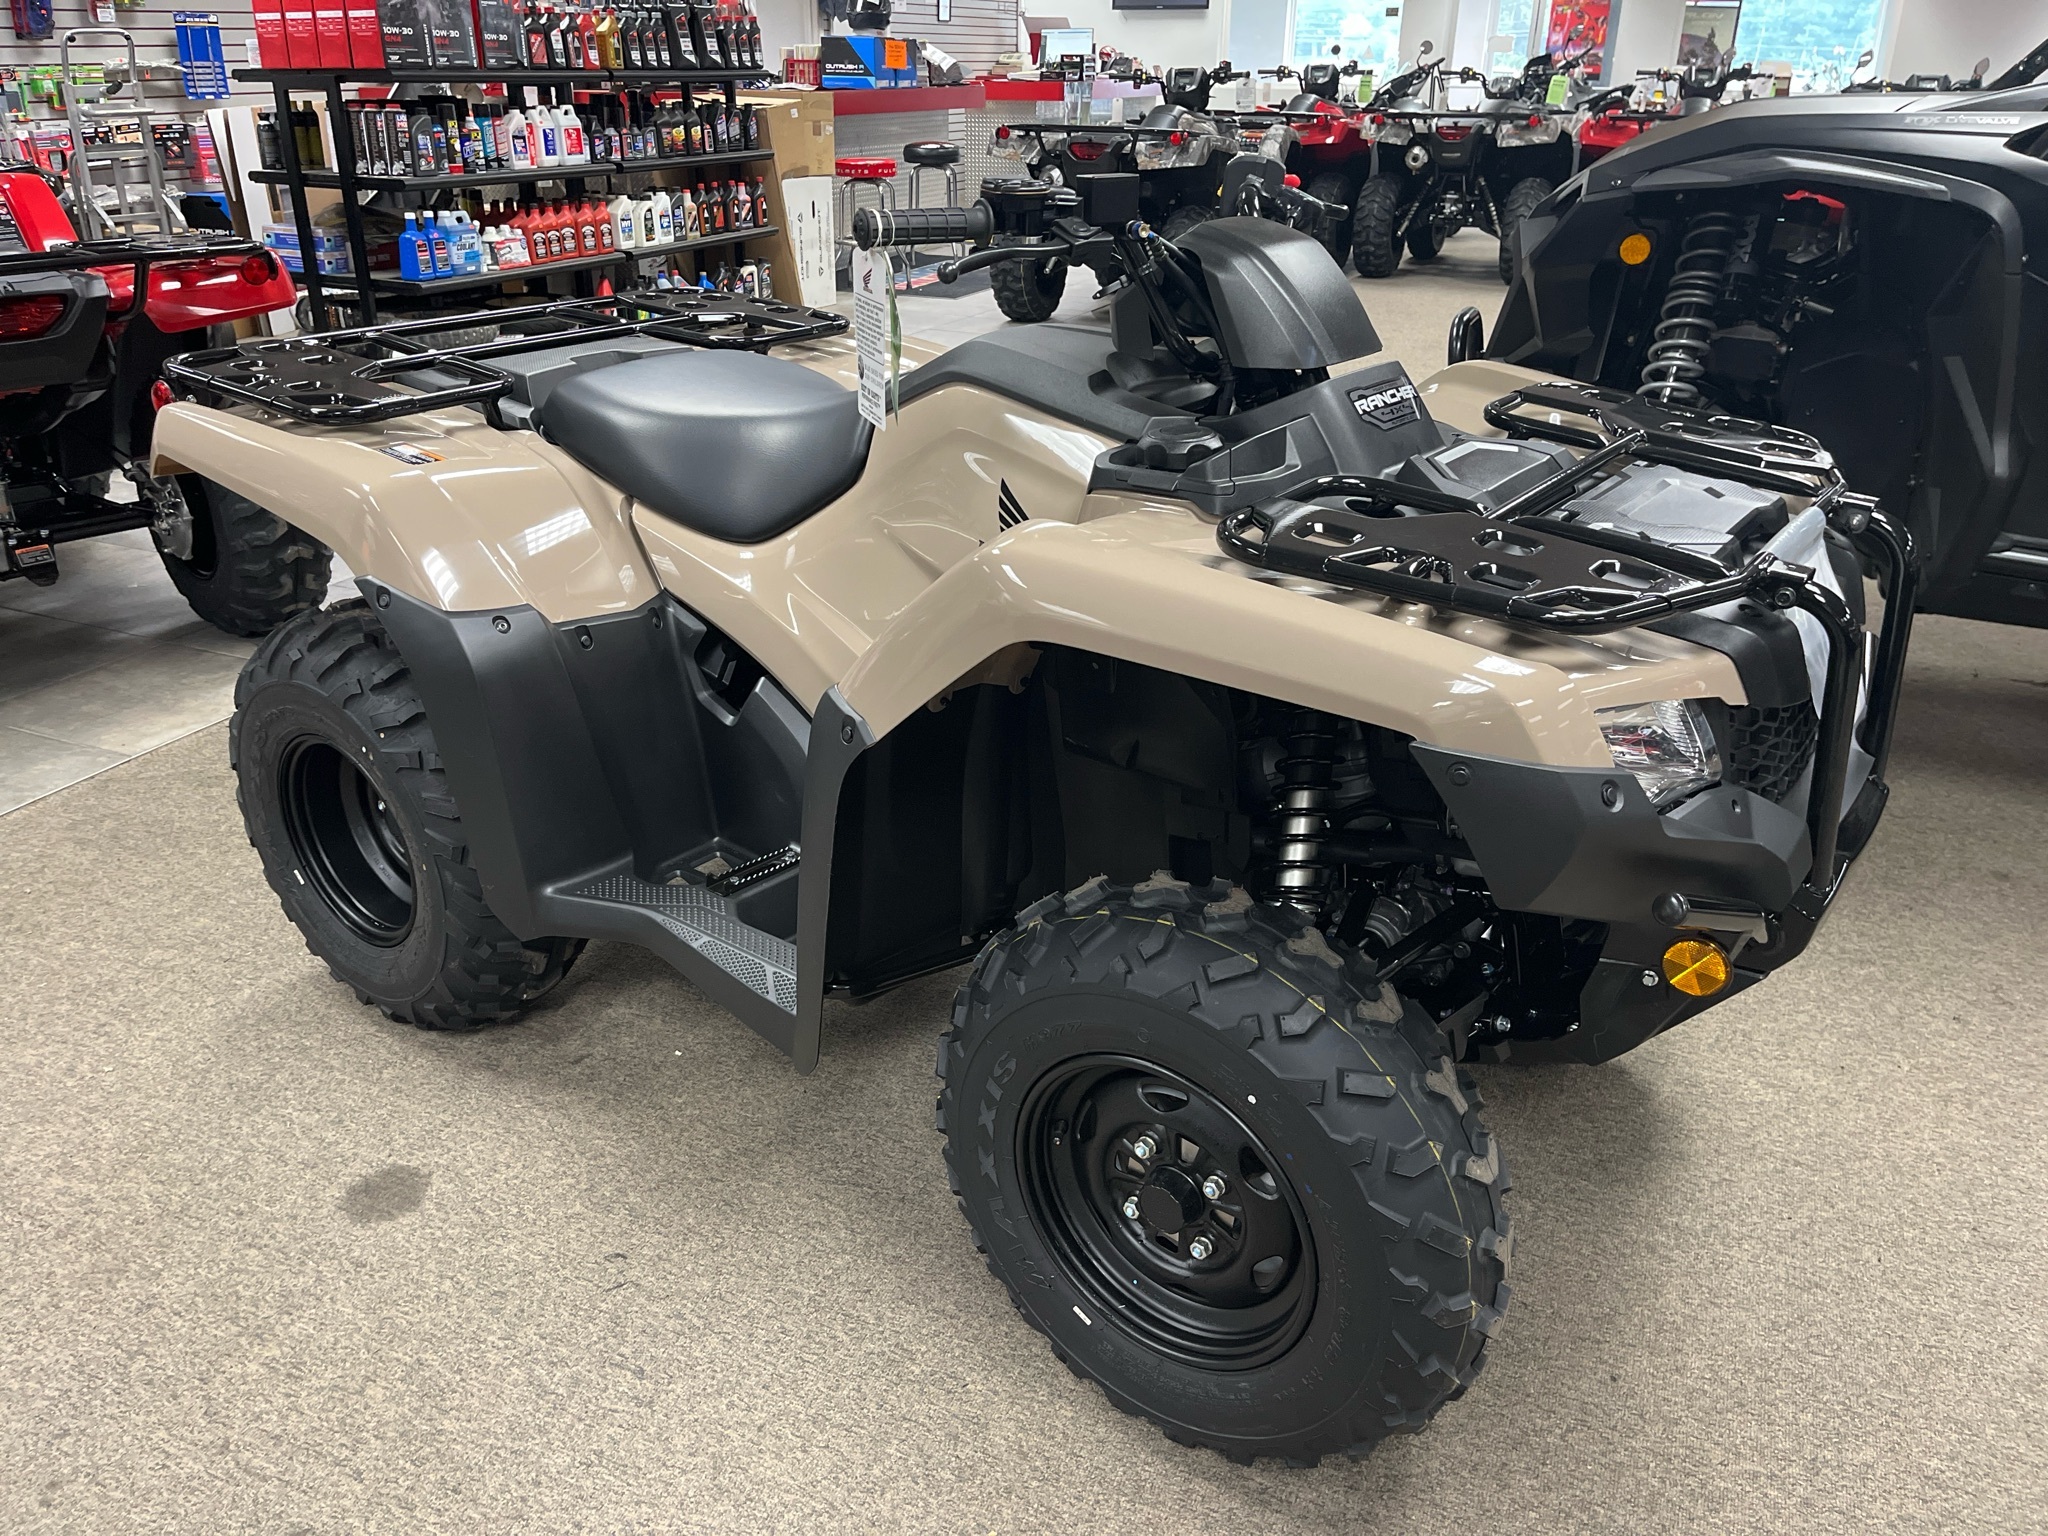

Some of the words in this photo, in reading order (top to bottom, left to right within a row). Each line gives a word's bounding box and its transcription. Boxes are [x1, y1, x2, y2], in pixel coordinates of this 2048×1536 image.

[382, 26, 414, 36] 10W-30
[431, 28, 460, 38] 10W-30
[384, 35, 402, 43] GN4
[484, 32, 508, 41] 10W-30
[456, 242, 476, 252] COOLANT
[1353, 384, 1418, 415] RANCHER
[977, 1050, 1055, 1291] MAXXIS
